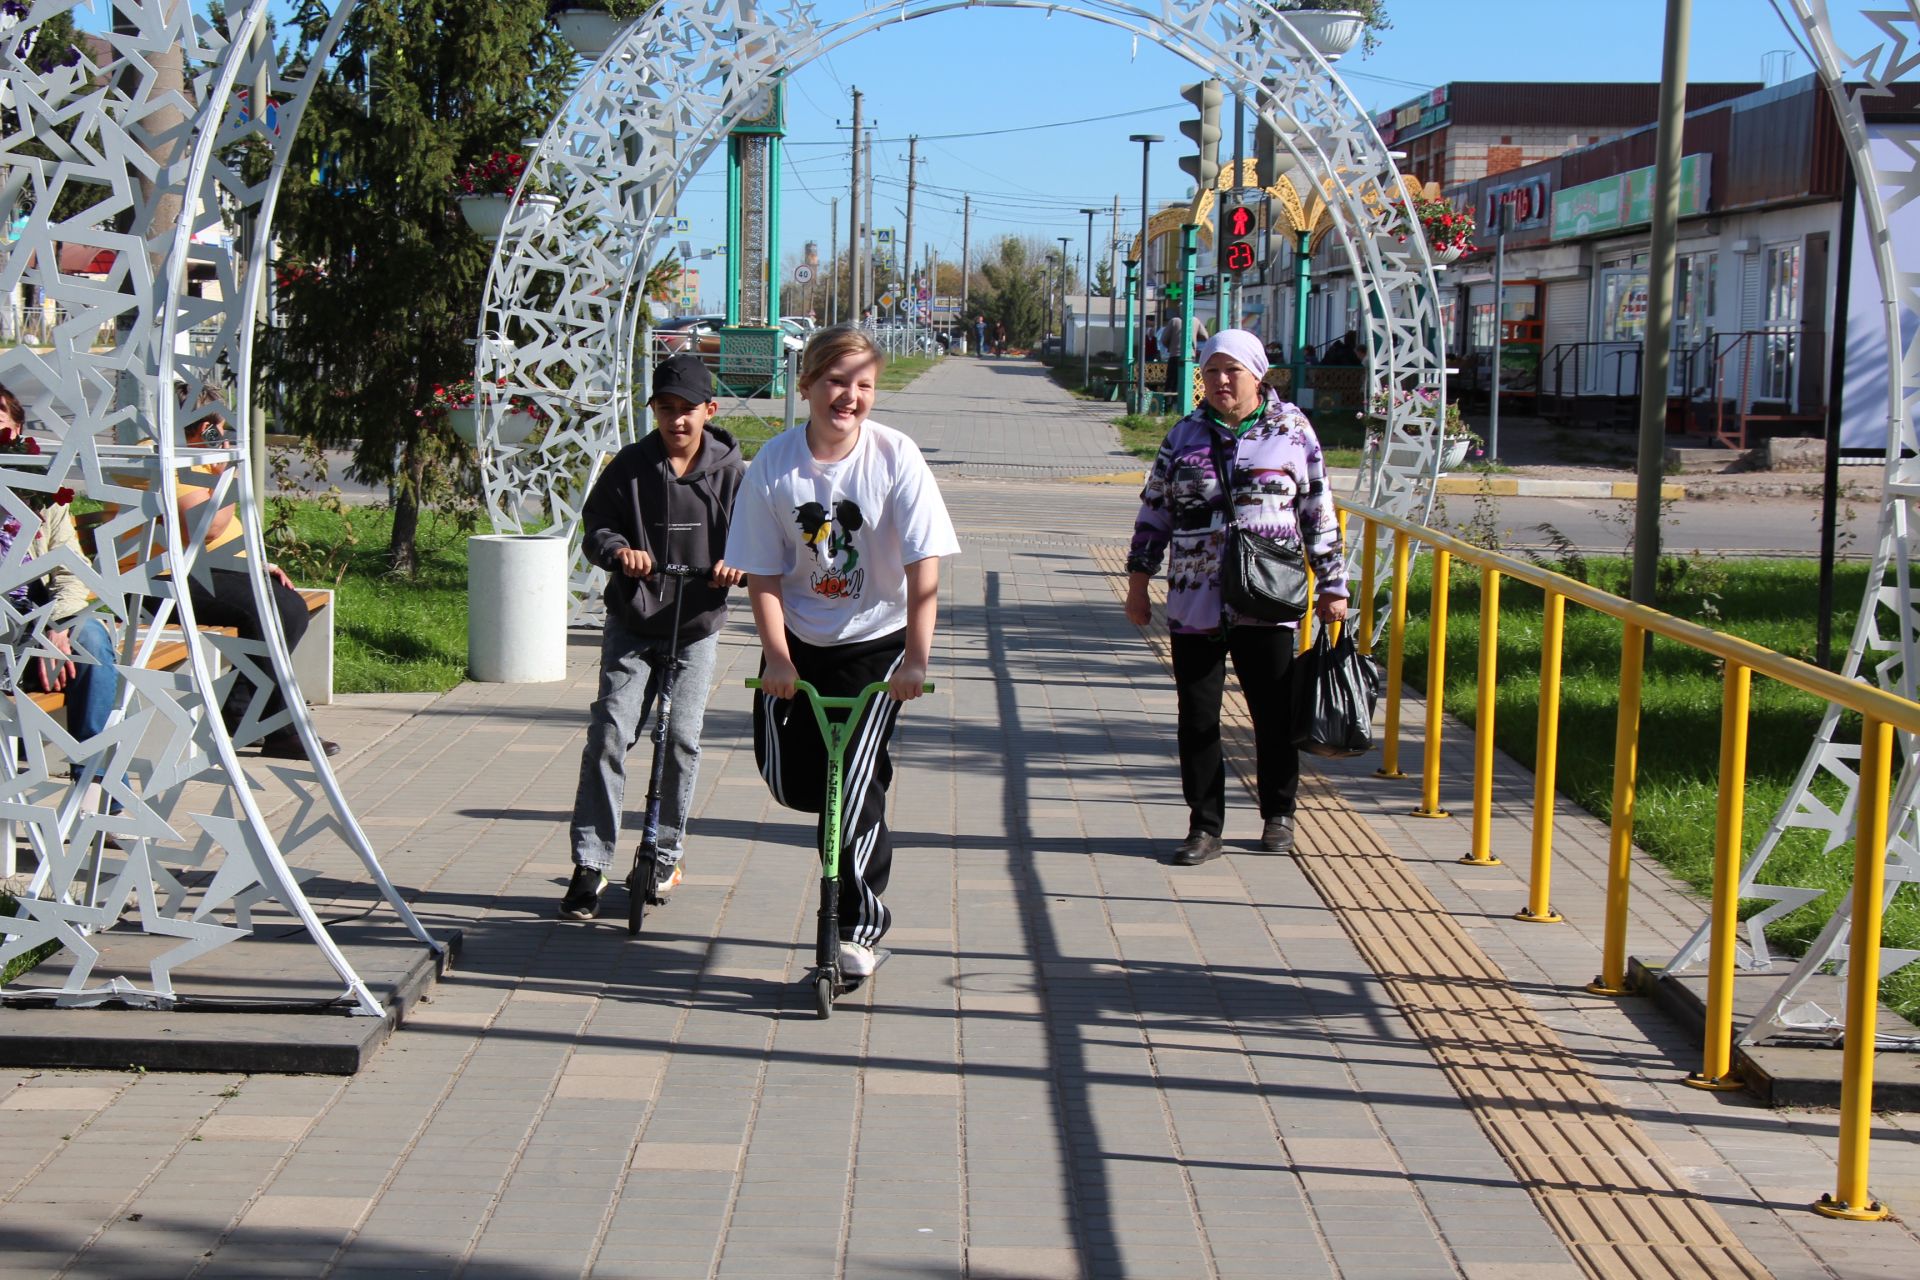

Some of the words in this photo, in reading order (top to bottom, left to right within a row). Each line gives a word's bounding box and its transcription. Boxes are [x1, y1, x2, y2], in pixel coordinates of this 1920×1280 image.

[1227, 244, 1252, 269] 23
[798, 270, 809, 278] 40
[811, 568, 864, 599] WOW!
